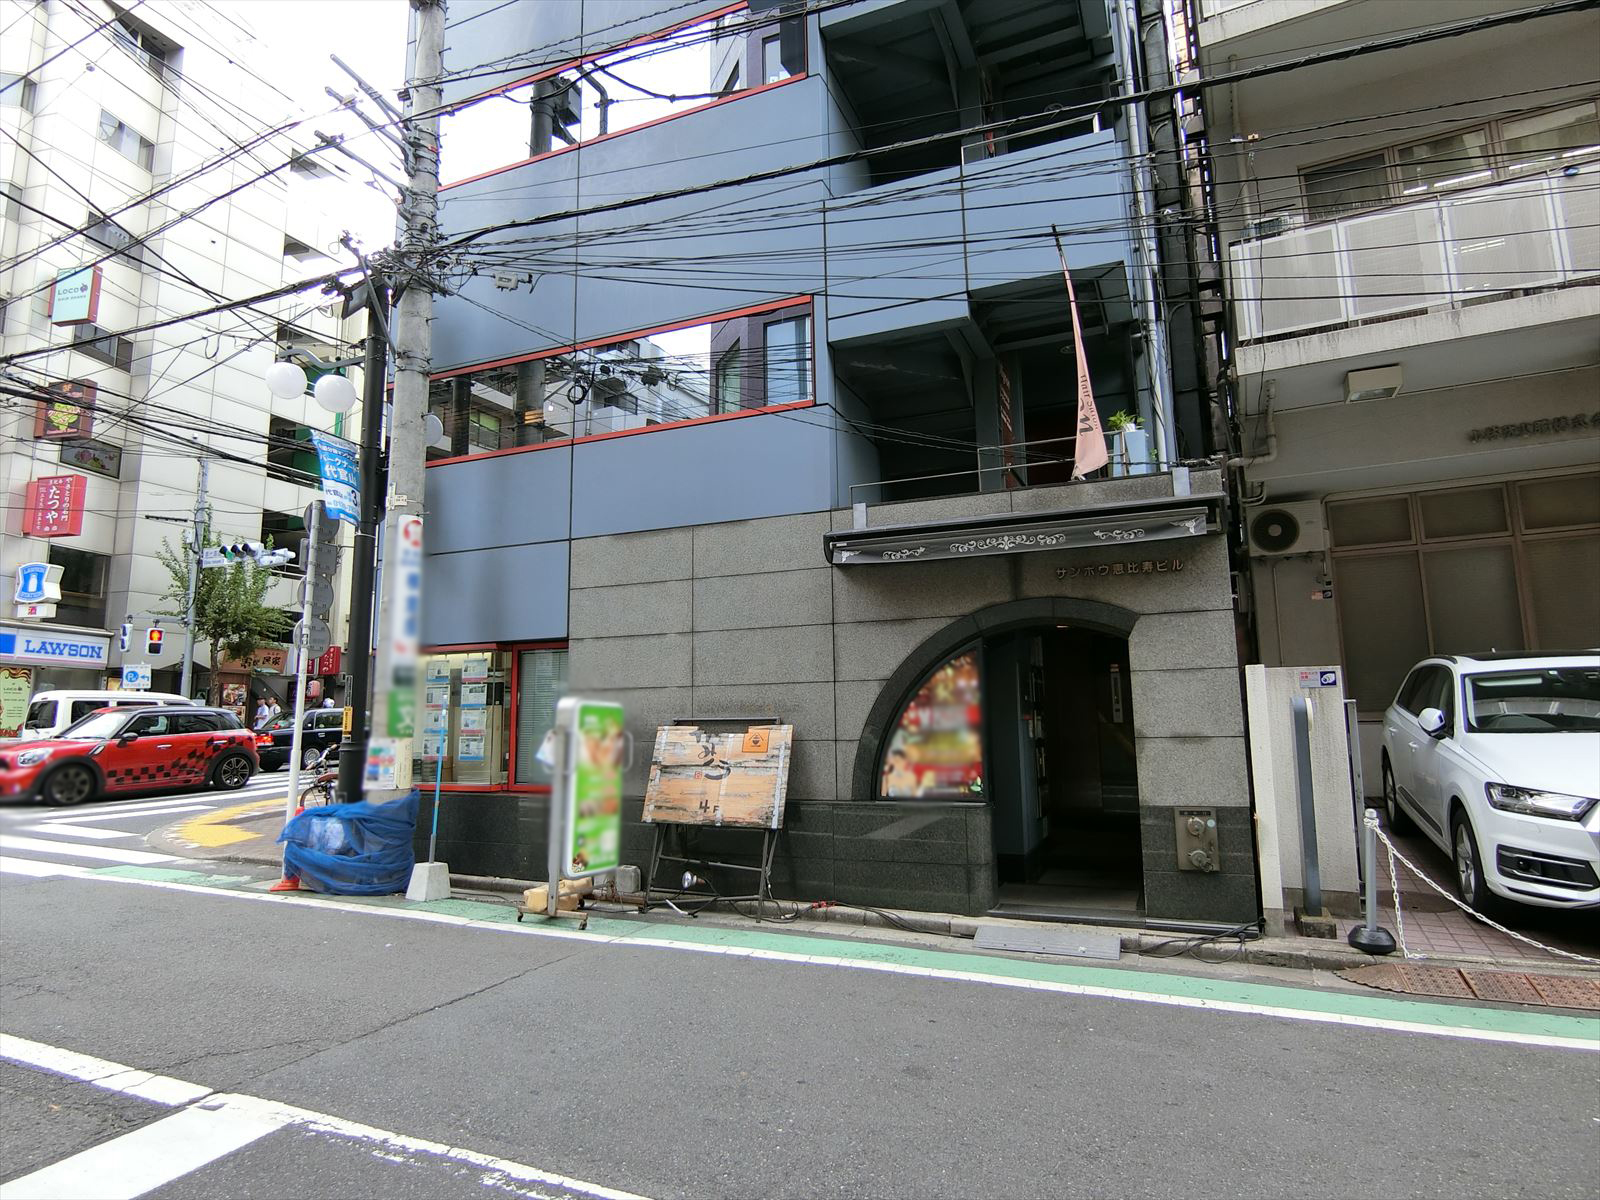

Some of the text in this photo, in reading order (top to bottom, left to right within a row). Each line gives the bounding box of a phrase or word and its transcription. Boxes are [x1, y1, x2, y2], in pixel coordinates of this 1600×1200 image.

[58, 287, 79, 295] LOCO
[46, 486, 61, 525] たつや
[1056, 559, 1184, 579] サンホウ恵比寿ビル
[24, 639, 103, 659] LAWSON
[699, 799, 719, 814] 4F
